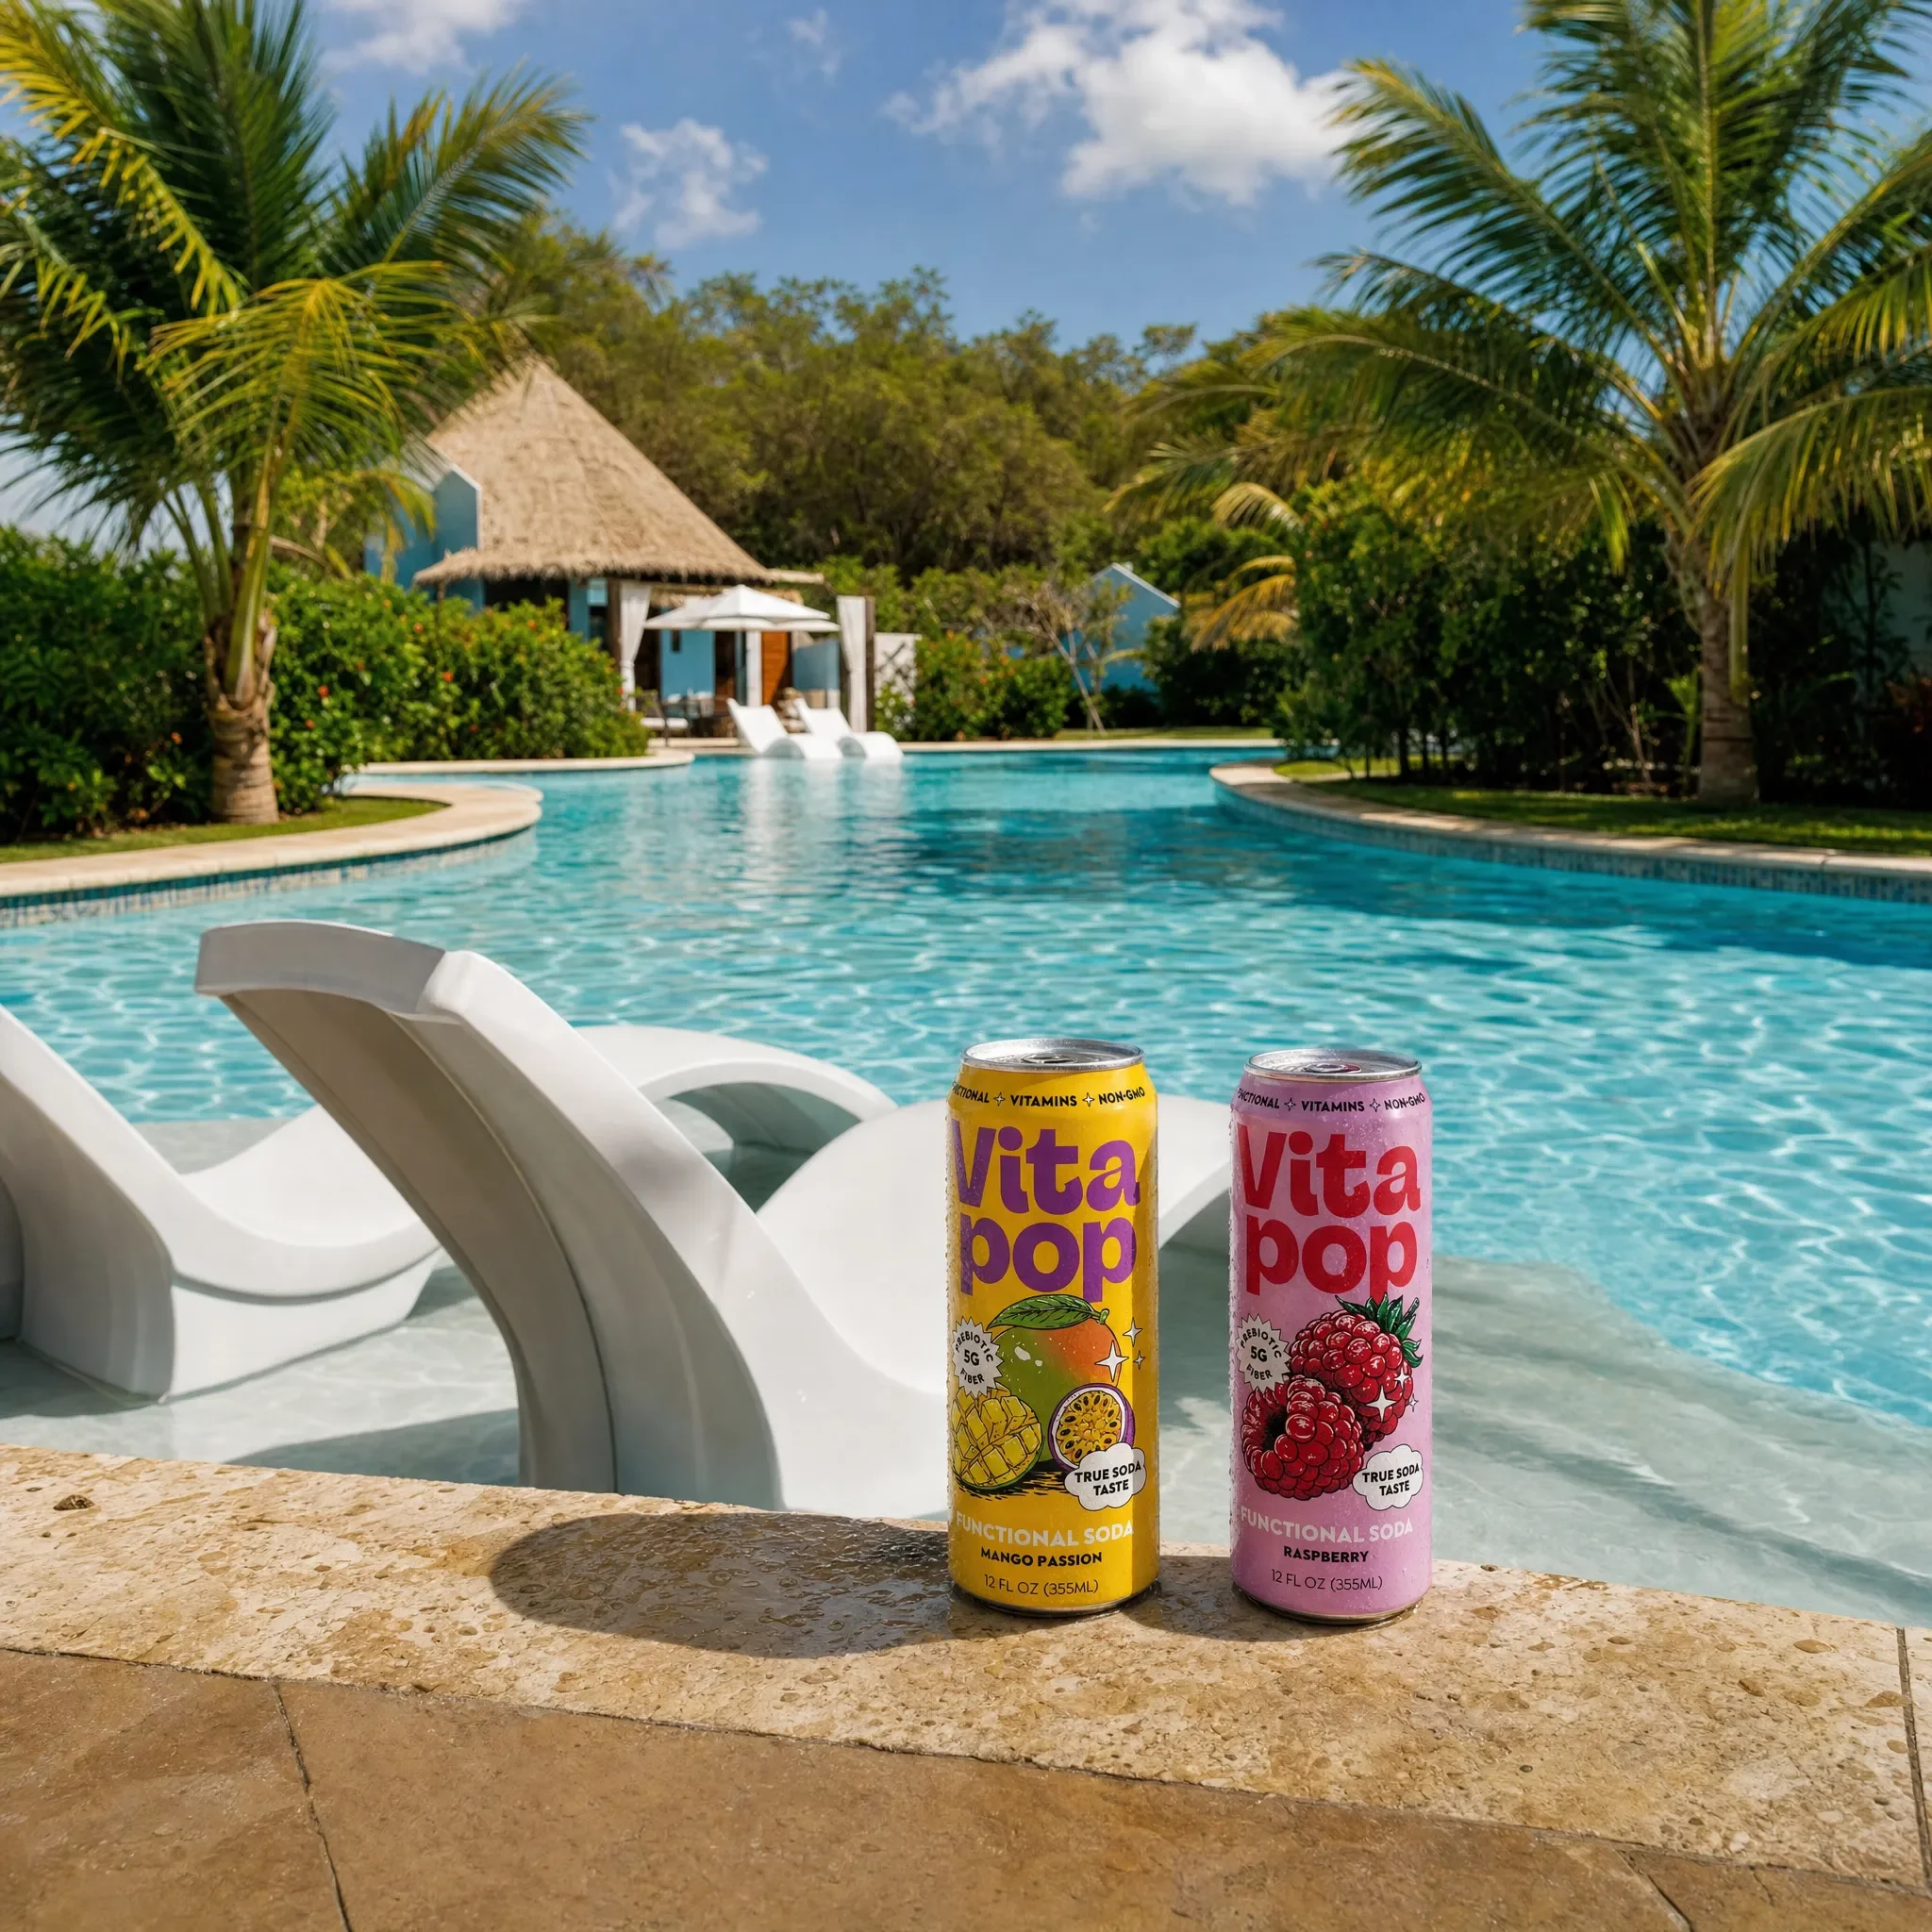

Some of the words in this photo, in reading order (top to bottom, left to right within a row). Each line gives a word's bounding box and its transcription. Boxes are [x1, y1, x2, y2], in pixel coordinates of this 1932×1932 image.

[1010, 1094, 1077, 1107] VITAMINS
[1098, 1086, 1145, 1105] NON-GMO
[1301, 1100, 1365, 1112] VITAMINS
[1384, 1091, 1425, 1110] NON-GMO
[952, 1119, 1141, 1215] Vita
[1238, 1123, 1421, 1219] Vita
[960, 1211, 1137, 1303] pop
[1246, 1214, 1418, 1306] pop
[955, 1331, 994, 1362] PREBIOTIC
[1240, 1327, 1282, 1358] PREBIOTIC
[1250, 1345, 1268, 1362] 5G
[963, 1348, 980, 1366] 5G
[959, 1367, 985, 1385] FIBER
[1246, 1363, 1273, 1380] FIBER
[1074, 1469, 1109, 1483] TRUE
[1112, 1460, 1141, 1478] SODA
[1361, 1470, 1394, 1483] TRUE
[1396, 1463, 1420, 1479] SODA
[1093, 1479, 1129, 1496] TASTE
[1379, 1480, 1410, 1496] TASTE
[956, 1510, 1079, 1547] FUNCTIONAL
[1084, 1520, 1134, 1545] SODA
[1241, 1506, 1365, 1543] FUNCTIONAL
[1369, 1517, 1413, 1542] SODA
[981, 1546, 1034, 1567] MANGO
[1038, 1552, 1103, 1567] PASSION
[1283, 1545, 1369, 1563] RASPBERRY
[984, 1574, 995, 1589] 12
[999, 1578, 1013, 1592] FL
[1017, 1581, 1039, 1595] OZ
[1043, 1579, 1099, 1597] (355ML)
[1271, 1569, 1283, 1584] 12
[1286, 1574, 1301, 1588] FL
[1305, 1576, 1325, 1591] OZ
[1330, 1575, 1383, 1592] (355ML)
